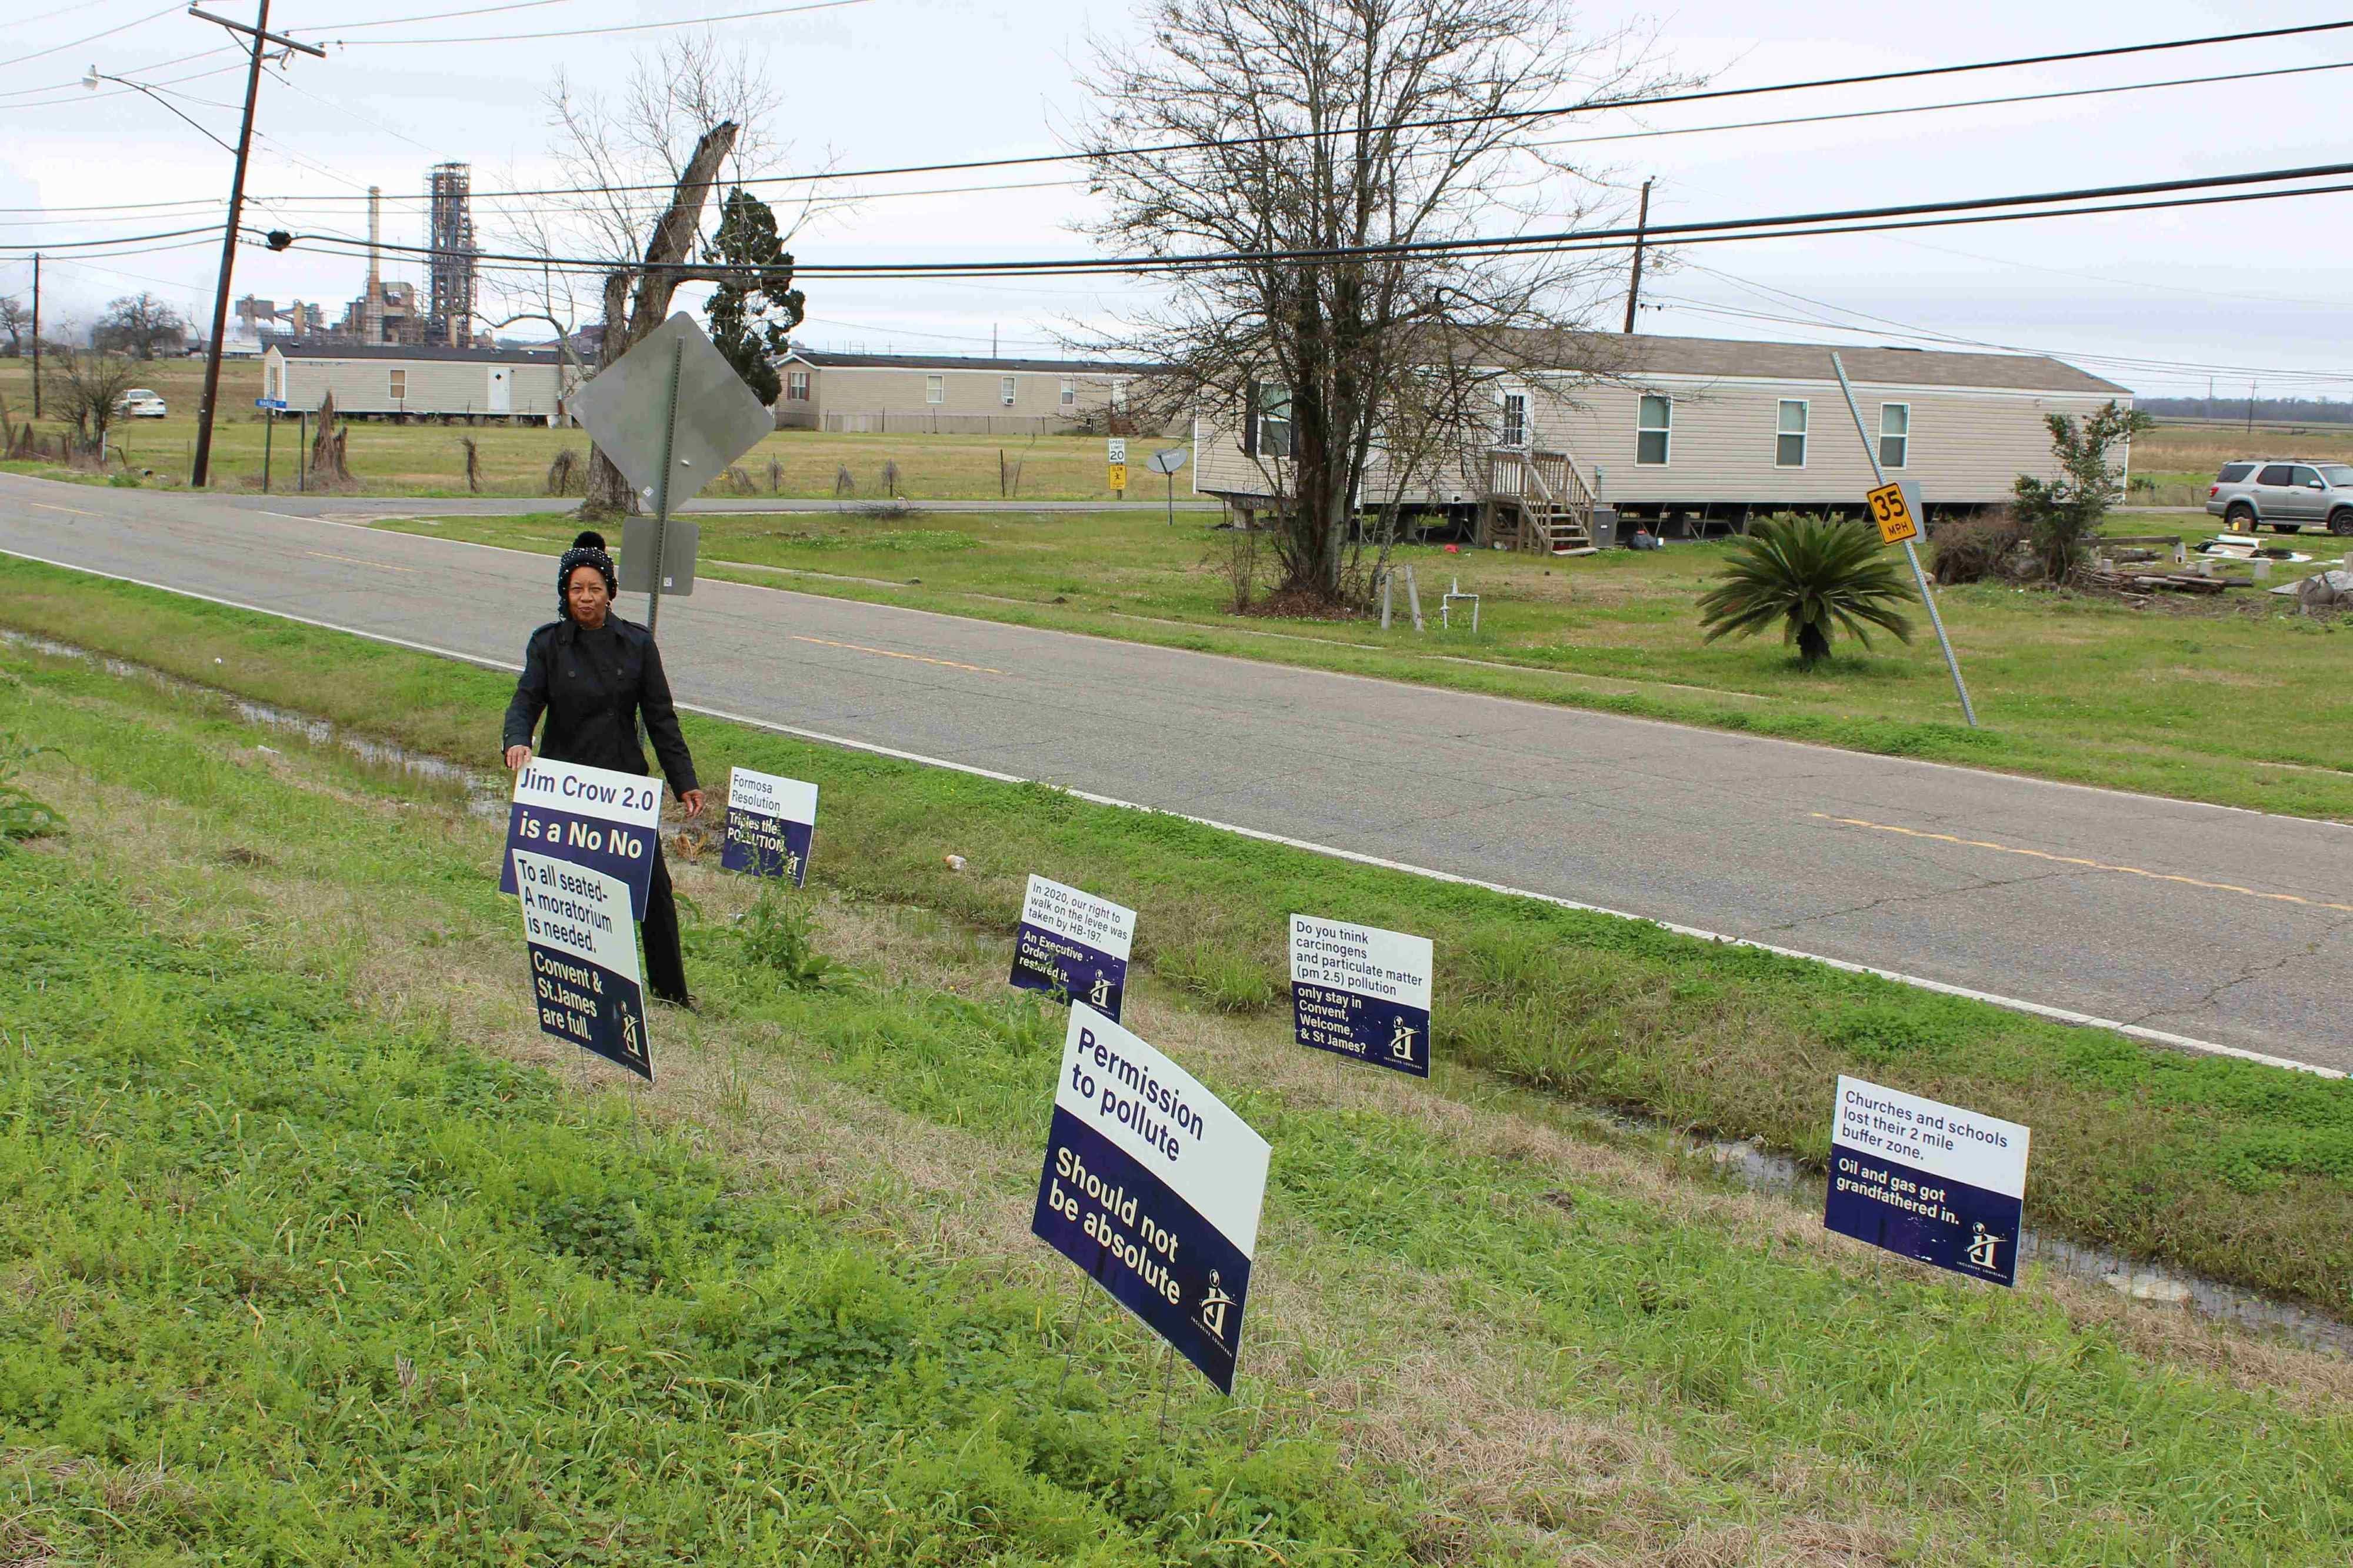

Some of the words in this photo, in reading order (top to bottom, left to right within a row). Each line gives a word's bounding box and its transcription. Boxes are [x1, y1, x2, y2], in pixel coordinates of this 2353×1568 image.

[1110, 451, 1124, 460] 20
[1874, 490, 1905, 521] 35
[1888, 521, 1909, 536] MPH
[521, 768, 555, 793] Jim
[562, 775, 616, 803] Crow
[622, 787, 653, 811] 2.0
[732, 790, 781, 812] Resolution
[734, 774, 772, 794] Formosa
[519, 811, 541, 839] is
[546, 823, 561, 843] a
[568, 822, 601, 850] No
[608, 829, 642, 859] No
[729, 812, 759, 830] Triples
[762, 818, 777, 835] the
[518, 859, 536, 882] To
[540, 865, 555, 888] all
[560, 873, 608, 902] seated-
[525, 886, 535, 908] A
[539, 894, 613, 933] moratorium
[1031, 896, 1052, 908] walk
[1054, 905, 1066, 915] on
[1068, 908, 1083, 922] the
[1085, 913, 1108, 932] levee
[1111, 928, 1128, 940] was
[1033, 882, 1041, 895] In
[1044, 887, 1068, 905] 2020,
[1072, 898, 1086, 909] our
[1089, 904, 1110, 919] right
[1112, 913, 1120, 923] to
[527, 912, 540, 934] is
[545, 921, 597, 953] needed.
[1028, 908, 1054, 925] taken
[1056, 919, 1068, 932] by
[1069, 924, 1102, 943] HB-197.
[1297, 921, 1312, 933] Do
[1316, 926, 1336, 938] you
[1022, 943, 1049, 961] Order
[1023, 930, 1037, 944] An
[1039, 936, 1083, 962] Executive
[1296, 938, 1367, 959] carcinogens
[534, 951, 590, 989] Convent
[593, 970, 604, 995] &
[1019, 956, 1059, 979] restored
[1060, 969, 1069, 983] it.
[1297, 952, 1318, 964] and
[1322, 957, 1383, 978] particulate
[1386, 970, 1422, 987] matter
[1297, 965, 1319, 979] (pm
[1323, 970, 1344, 986] 2.5)
[1348, 976, 1397, 996] pollution
[1298, 987, 1322, 1001] only
[1325, 992, 1349, 1009] stay
[1352, 995, 1362, 1009] in
[1299, 1000, 1349, 1022] Convent,
[542, 1007, 565, 1029] are
[567, 1010, 592, 1040] full.
[1299, 1013, 1354, 1037] Welcome,
[1301, 1027, 1310, 1040] &
[1312, 1030, 1325, 1044] St
[1327, 1035, 1367, 1055] James?
[1078, 1026, 1204, 1142] Permission
[1072, 1063, 1095, 1099] to
[1101, 1087, 1180, 1162] pollute
[1844, 1106, 1869, 1126] lost
[1873, 1115, 1907, 1136] their
[1911, 1127, 1918, 1140] 2
[1923, 1131, 1954, 1151] mile
[1845, 1090, 1912, 1120] Churches
[1917, 1112, 1944, 1130] and
[1948, 1122, 2007, 1148] schools
[1842, 1124, 1882, 1147] buffer
[1886, 1140, 1924, 1160] zone.
[1838, 1157, 1858, 1175] Oil
[1861, 1166, 1887, 1185] and
[1891, 1176, 1916, 1193] gas
[1919, 1185, 1946, 1202] got
[1056, 1146, 1138, 1228] Should
[1141, 1214, 1179, 1265] not
[1836, 1176, 1938, 1219] grandfathered
[1941, 1207, 1960, 1225] in.
[1049, 1177, 1078, 1222] be
[1083, 1210, 1181, 1305] absolute
